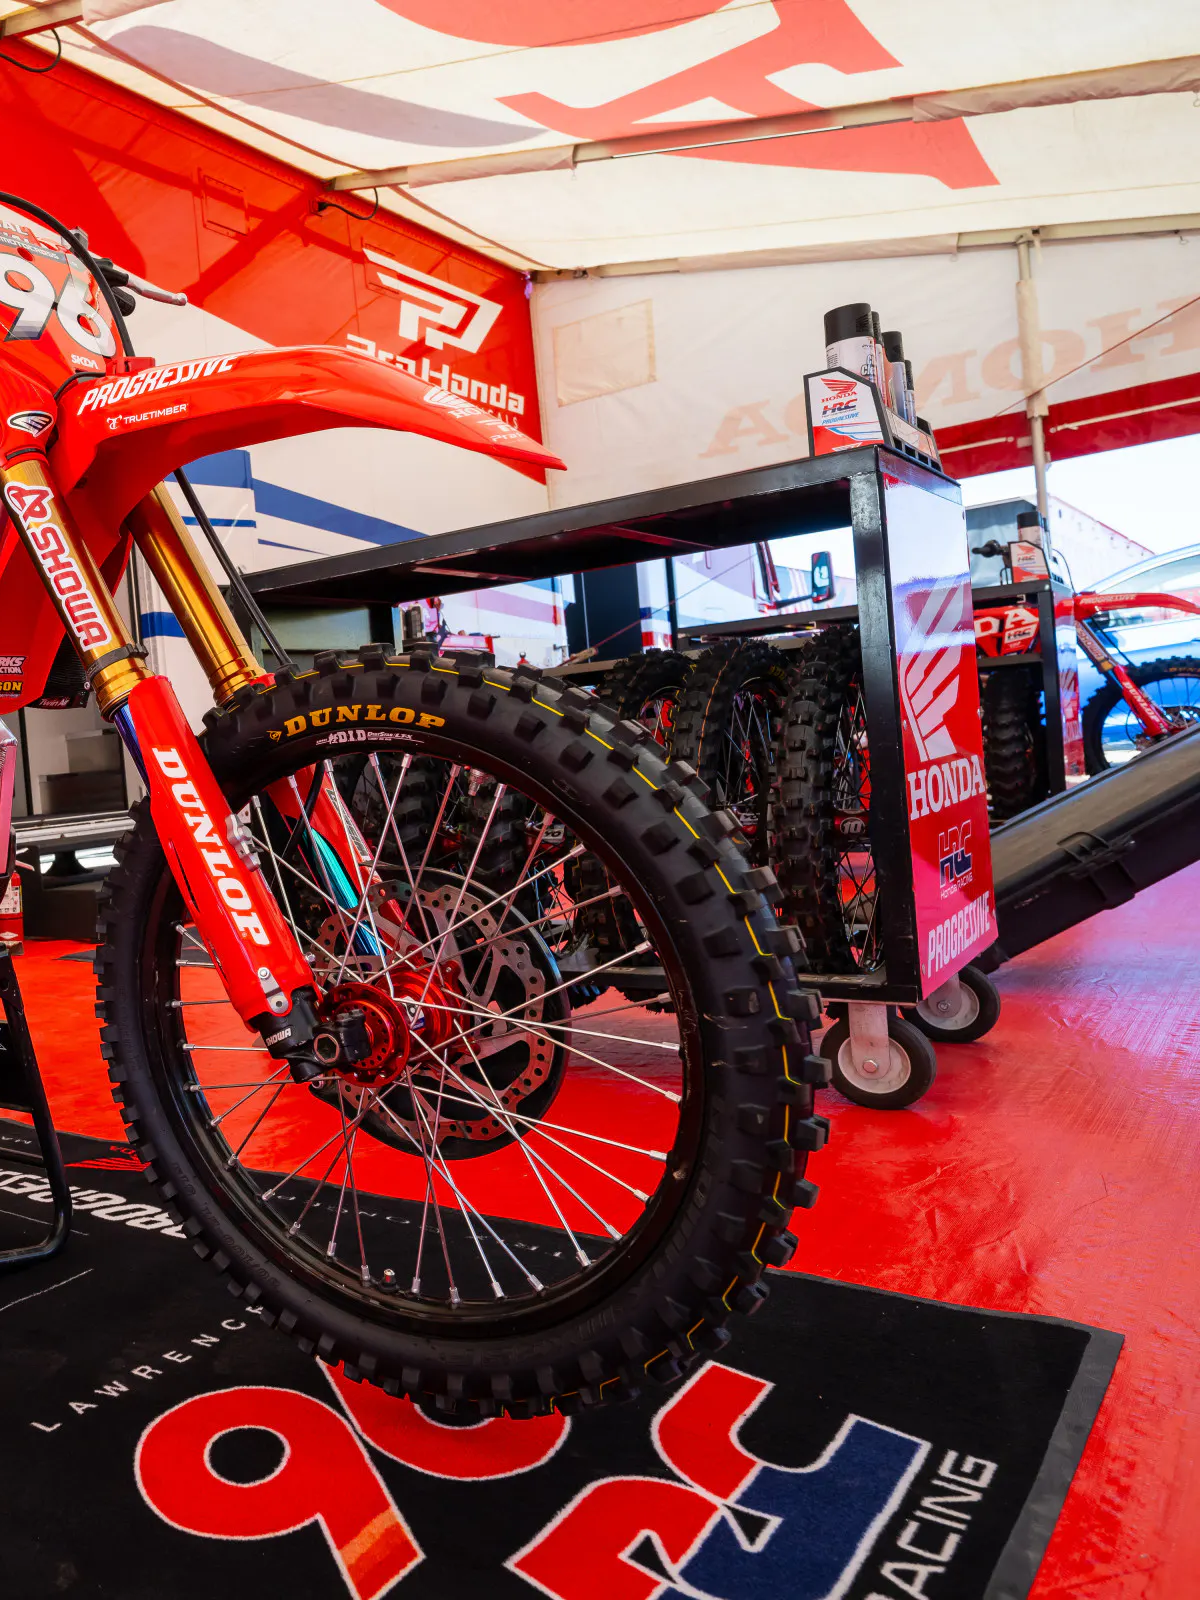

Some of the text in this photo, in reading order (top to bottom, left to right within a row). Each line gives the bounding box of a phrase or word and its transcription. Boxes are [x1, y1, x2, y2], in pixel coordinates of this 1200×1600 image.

[77, 355, 237, 415] PROGRESSIVE
[123, 404, 188, 426] TRUETIMBER
[821, 391, 858, 403] HONDA
[821, 412, 860, 425] PROGRESSIVE
[822, 399, 858, 415] HRC
[30, 528, 109, 649] SHOWA
[284, 704, 446, 737] DUNLOP
[907, 754, 985, 821] HONDA
[152, 746, 271, 947] DUNLOP
[938, 819, 972, 888] HRC
[927, 890, 991, 979] PROGRESSIVE
[30, 1304, 265, 1433] LAWRENCE
[863, 1449, 999, 1600] ACING
